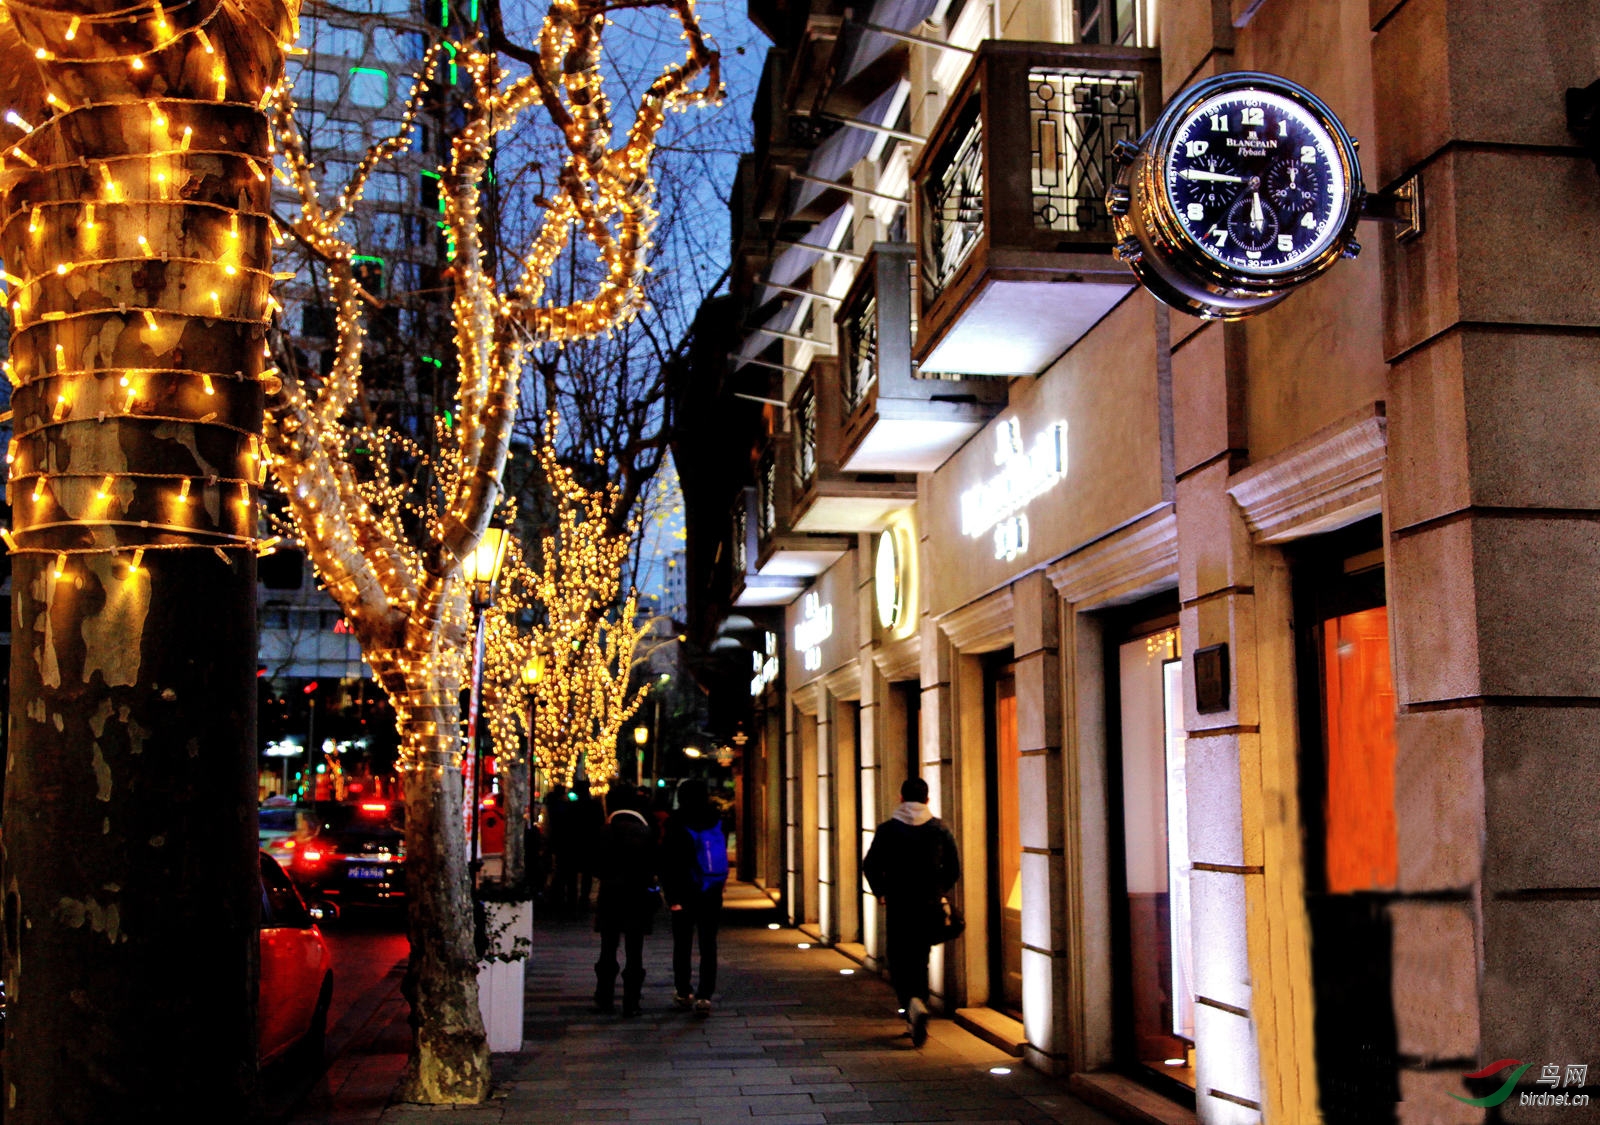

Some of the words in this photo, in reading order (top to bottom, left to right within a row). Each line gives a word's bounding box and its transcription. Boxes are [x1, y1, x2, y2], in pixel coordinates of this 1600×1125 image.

[1210, 114, 1228, 132] 11
[1241, 107, 1264, 126] 12
[1278, 119, 1288, 137] 1
[1185, 140, 1209, 157] 10
[1226, 137, 1278, 148] BLANCPAIN
[1238, 147, 1266, 157] Flyback
[1300, 145, 1316, 164] 2
[1208, 193, 1216, 201] 6
[1275, 189, 1288, 197] 20
[1301, 191, 1312, 199] 10
[1187, 202, 1204, 221] 8
[1300, 211, 1317, 230] 4
[1212, 229, 1229, 247] 7
[1277, 234, 1294, 251] 5
